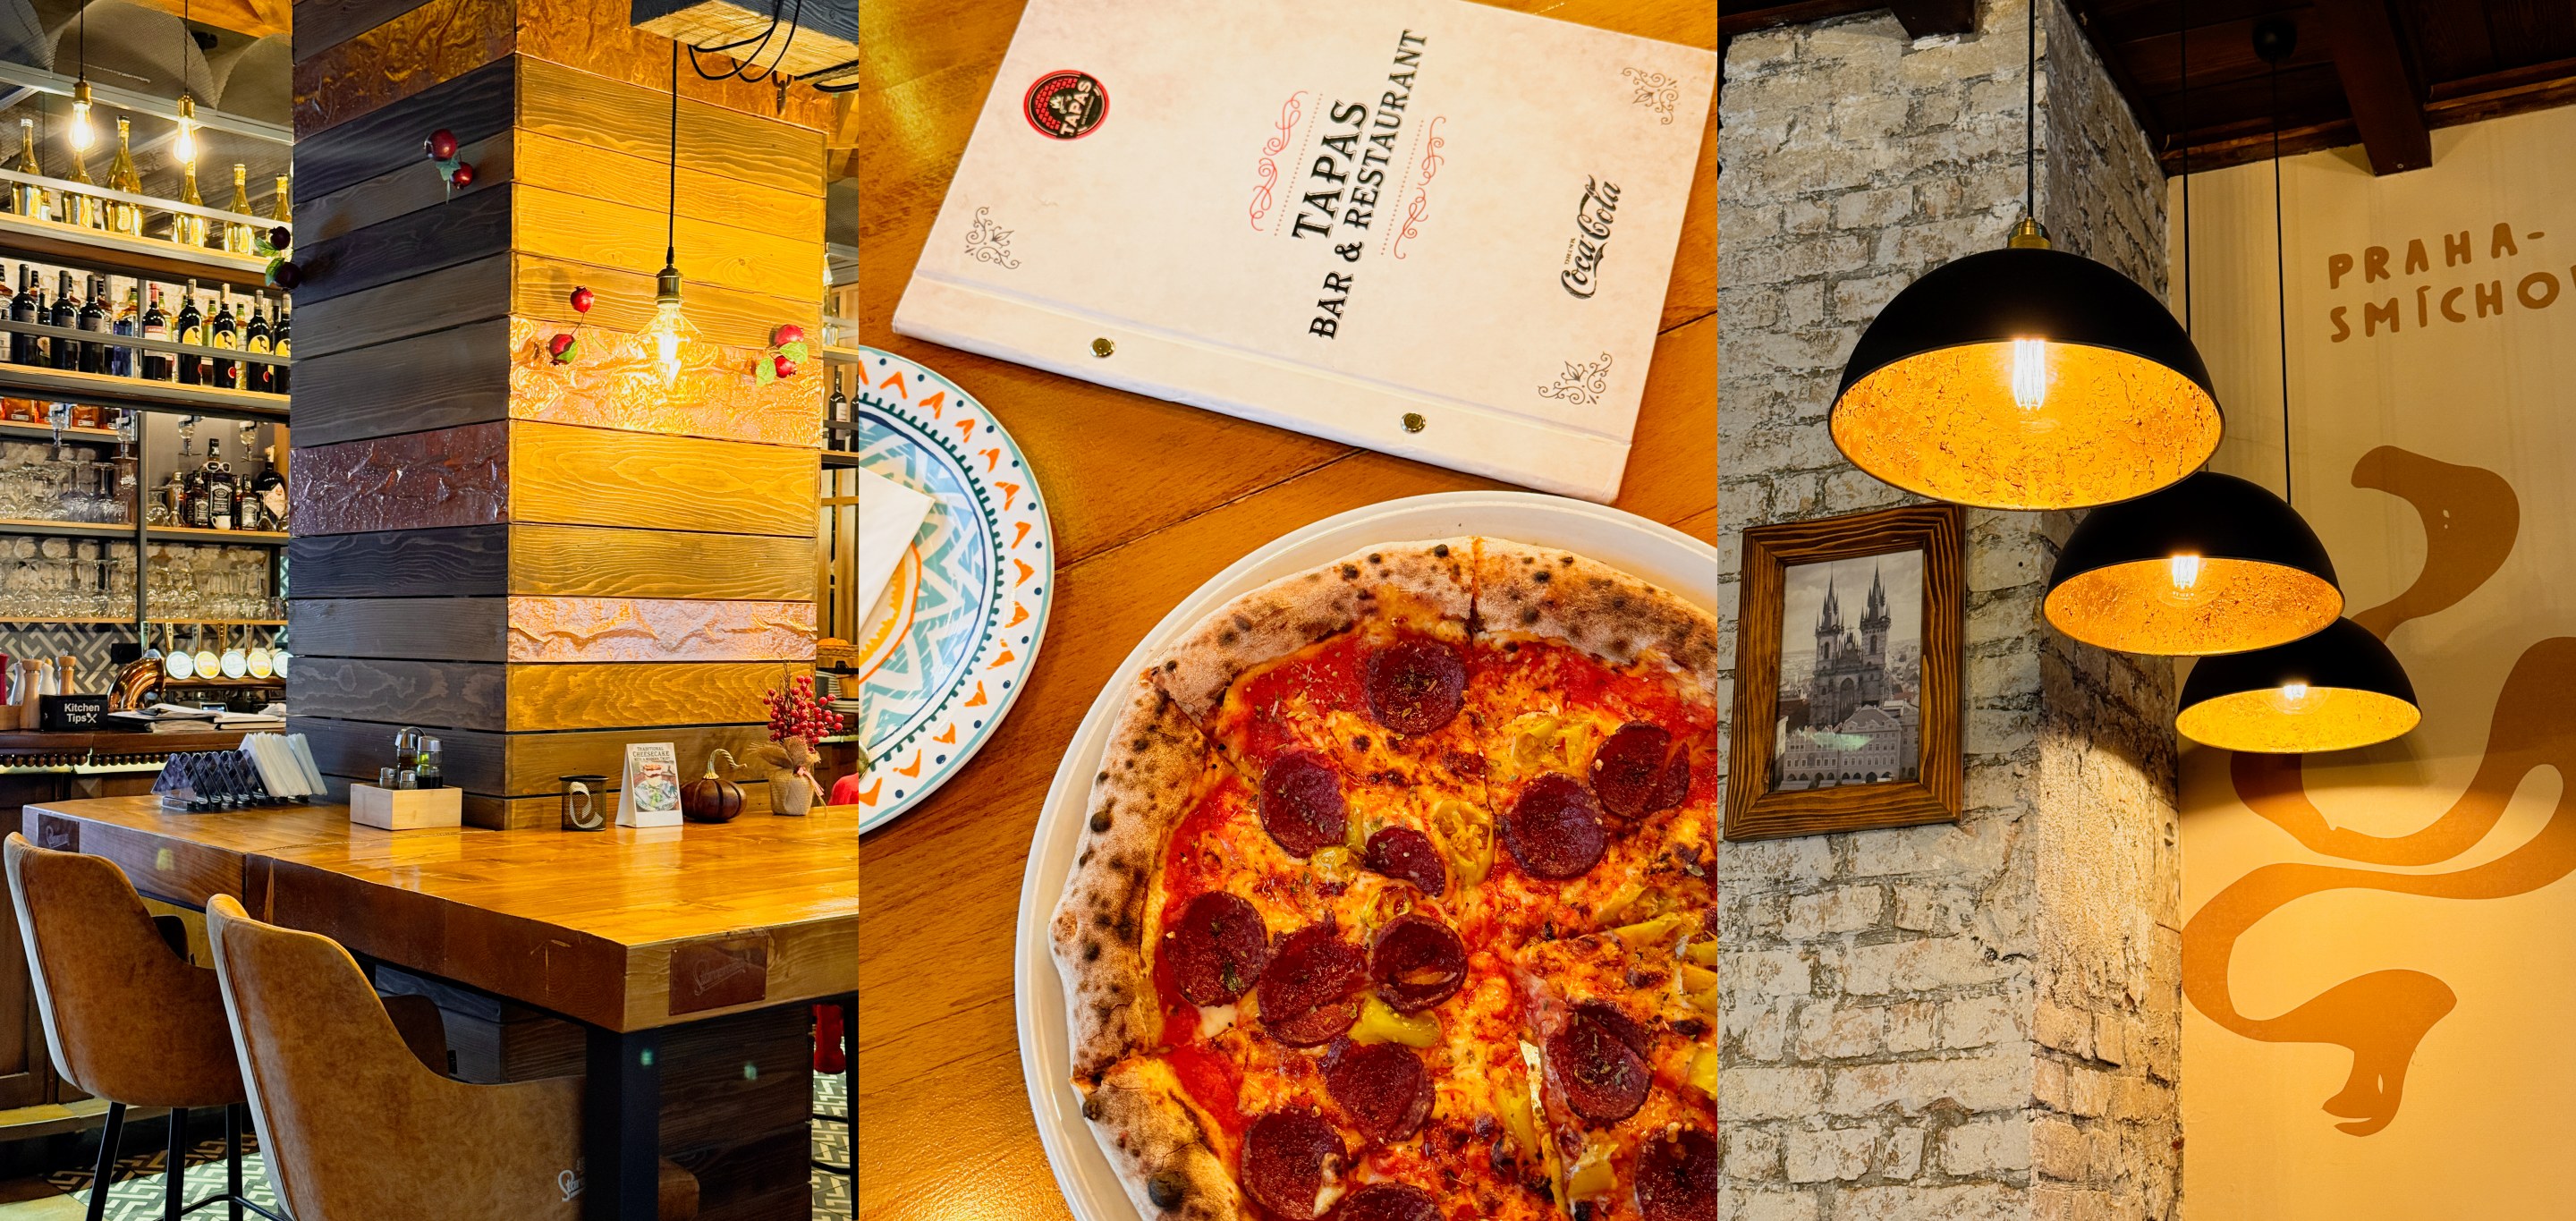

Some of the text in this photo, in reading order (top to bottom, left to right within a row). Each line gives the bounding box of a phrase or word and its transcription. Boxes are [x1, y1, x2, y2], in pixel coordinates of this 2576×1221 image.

[1059, 81, 1091, 134] TAPAS
[1292, 99, 1368, 240] TAPAS
[1309, 29, 1428, 340] BAR & RESTAURANT
[2328, 222, 2546, 290] PRAHA-
[64, 702, 100, 712] Kitchen
[66, 713, 87, 725] Tips
